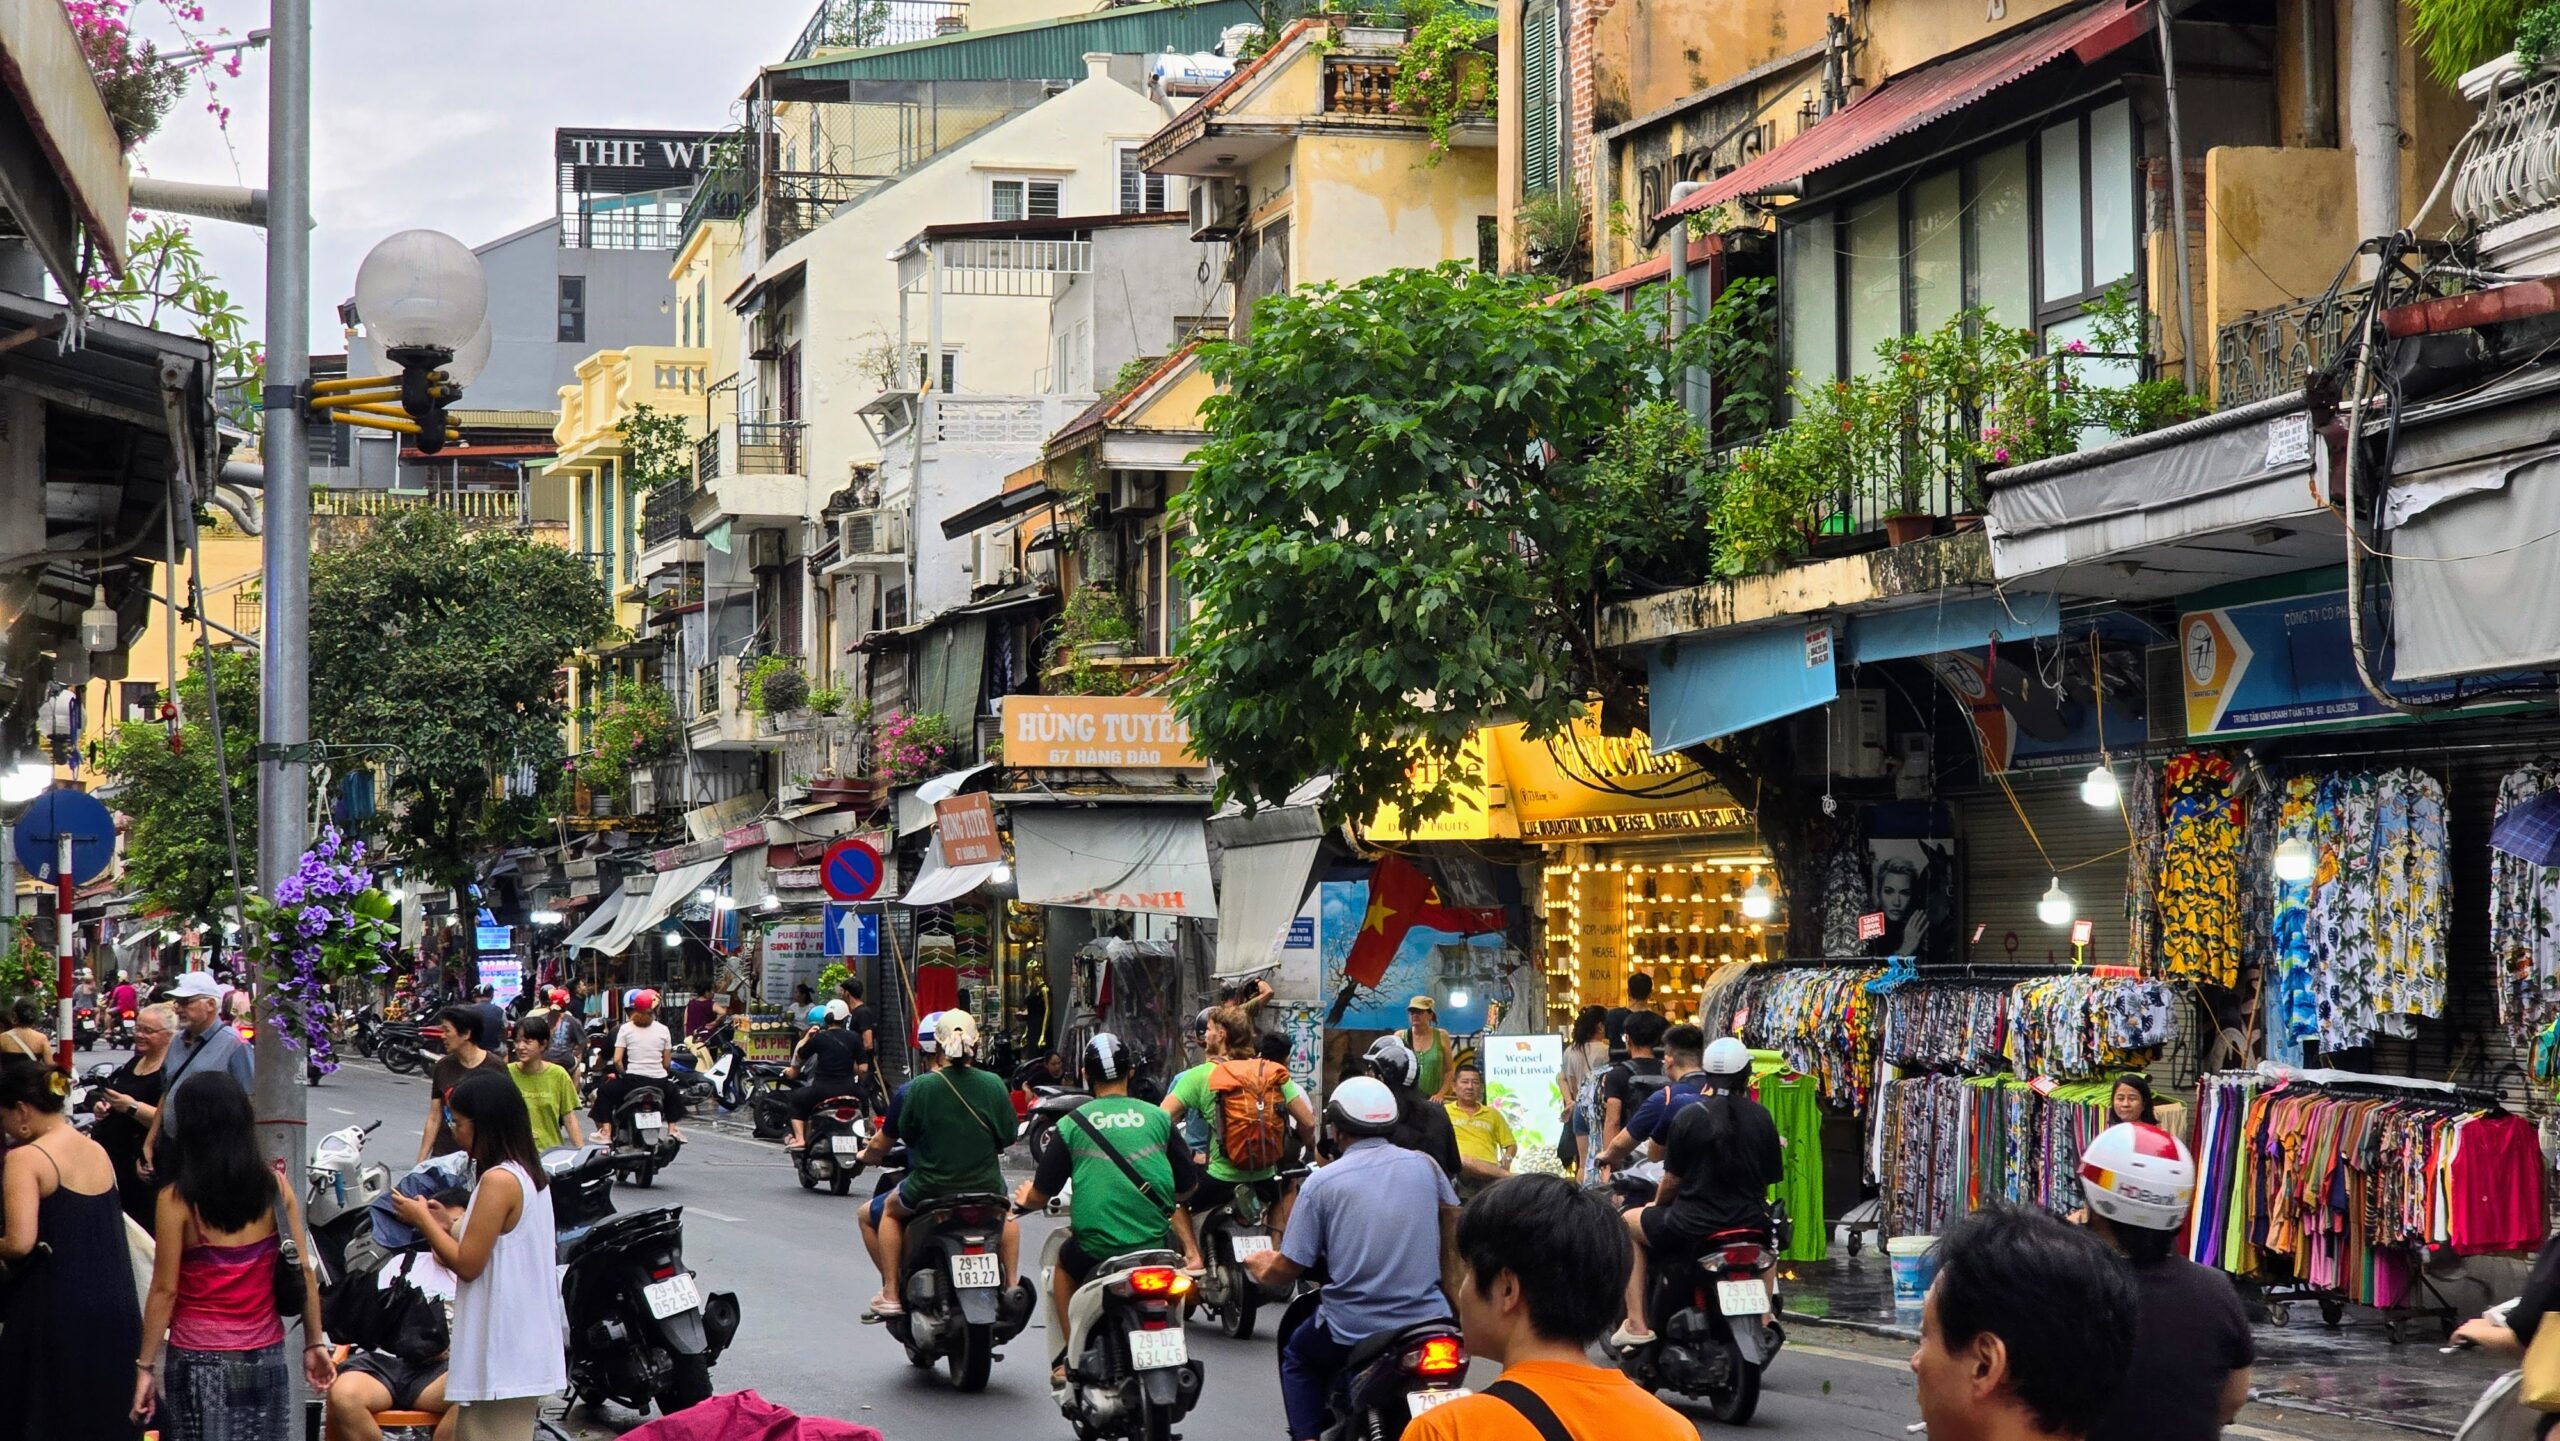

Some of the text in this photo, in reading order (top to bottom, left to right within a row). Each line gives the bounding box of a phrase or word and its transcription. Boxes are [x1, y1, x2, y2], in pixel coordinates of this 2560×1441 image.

[572, 139, 645, 167] THE
[1017, 704, 1096, 743] HÙNG
[1050, 747, 1161, 765] 67 HÀNG ĐÀO
[770, 942, 793, 951] SINH
[1589, 968, 1611, 980] MOKA
[1505, 1053, 1542, 1063] Weasel
[1494, 1065, 1555, 1077] Kopi Luwak
[1088, 1108, 1145, 1130] Grab
[959, 1256, 991, 1271] 29-T1
[958, 1271, 995, 1286] 183.27
[652, 1279, 686, 1301] 29-A1
[654, 1291, 697, 1316] 052.56
